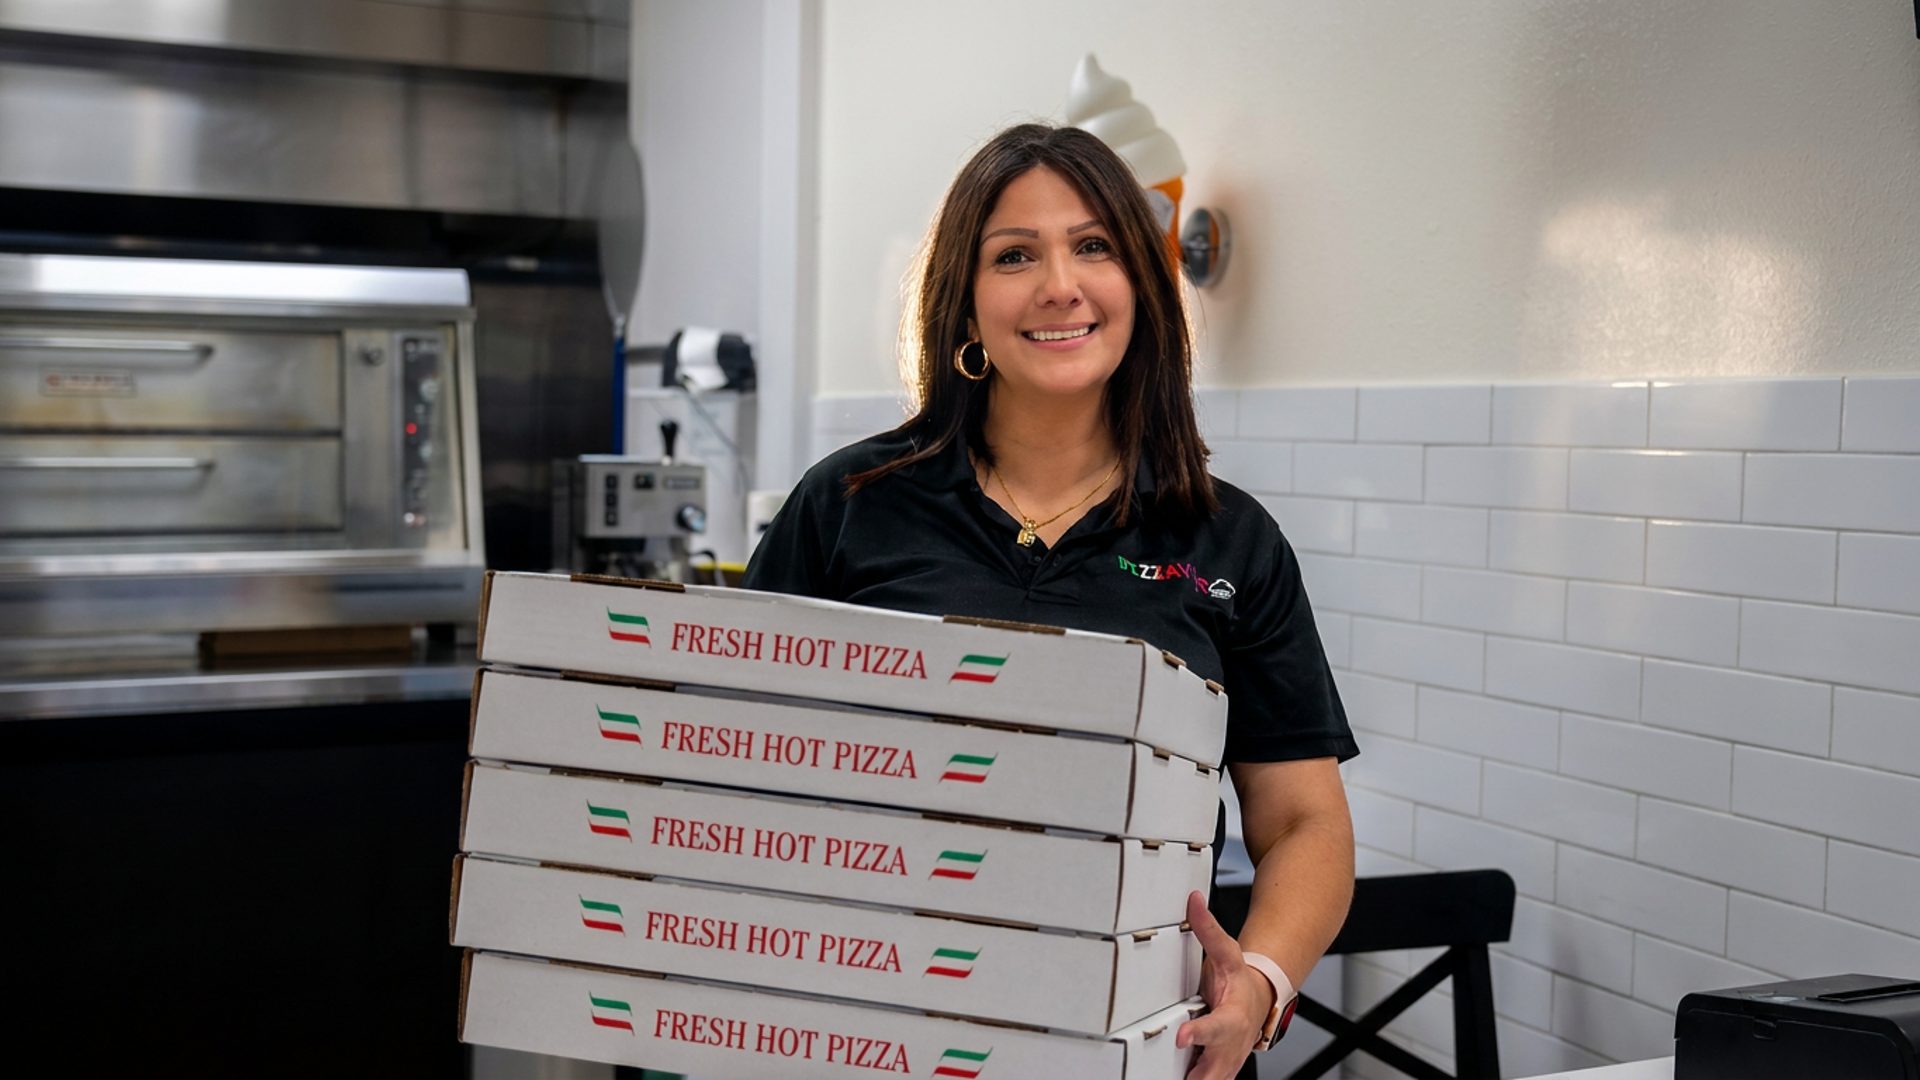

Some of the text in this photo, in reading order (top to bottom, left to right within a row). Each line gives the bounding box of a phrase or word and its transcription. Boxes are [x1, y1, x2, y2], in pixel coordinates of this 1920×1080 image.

[672, 623, 926, 679] FRESH HOT PIZZA
[661, 721, 916, 779] FRESH HOT PIZZA
[651, 817, 907, 876] FRESH HOT PIZZA
[646, 912, 902, 973] FRESH HOT PIZZA
[655, 1009, 909, 1073] FRESH HOT PIZZA
